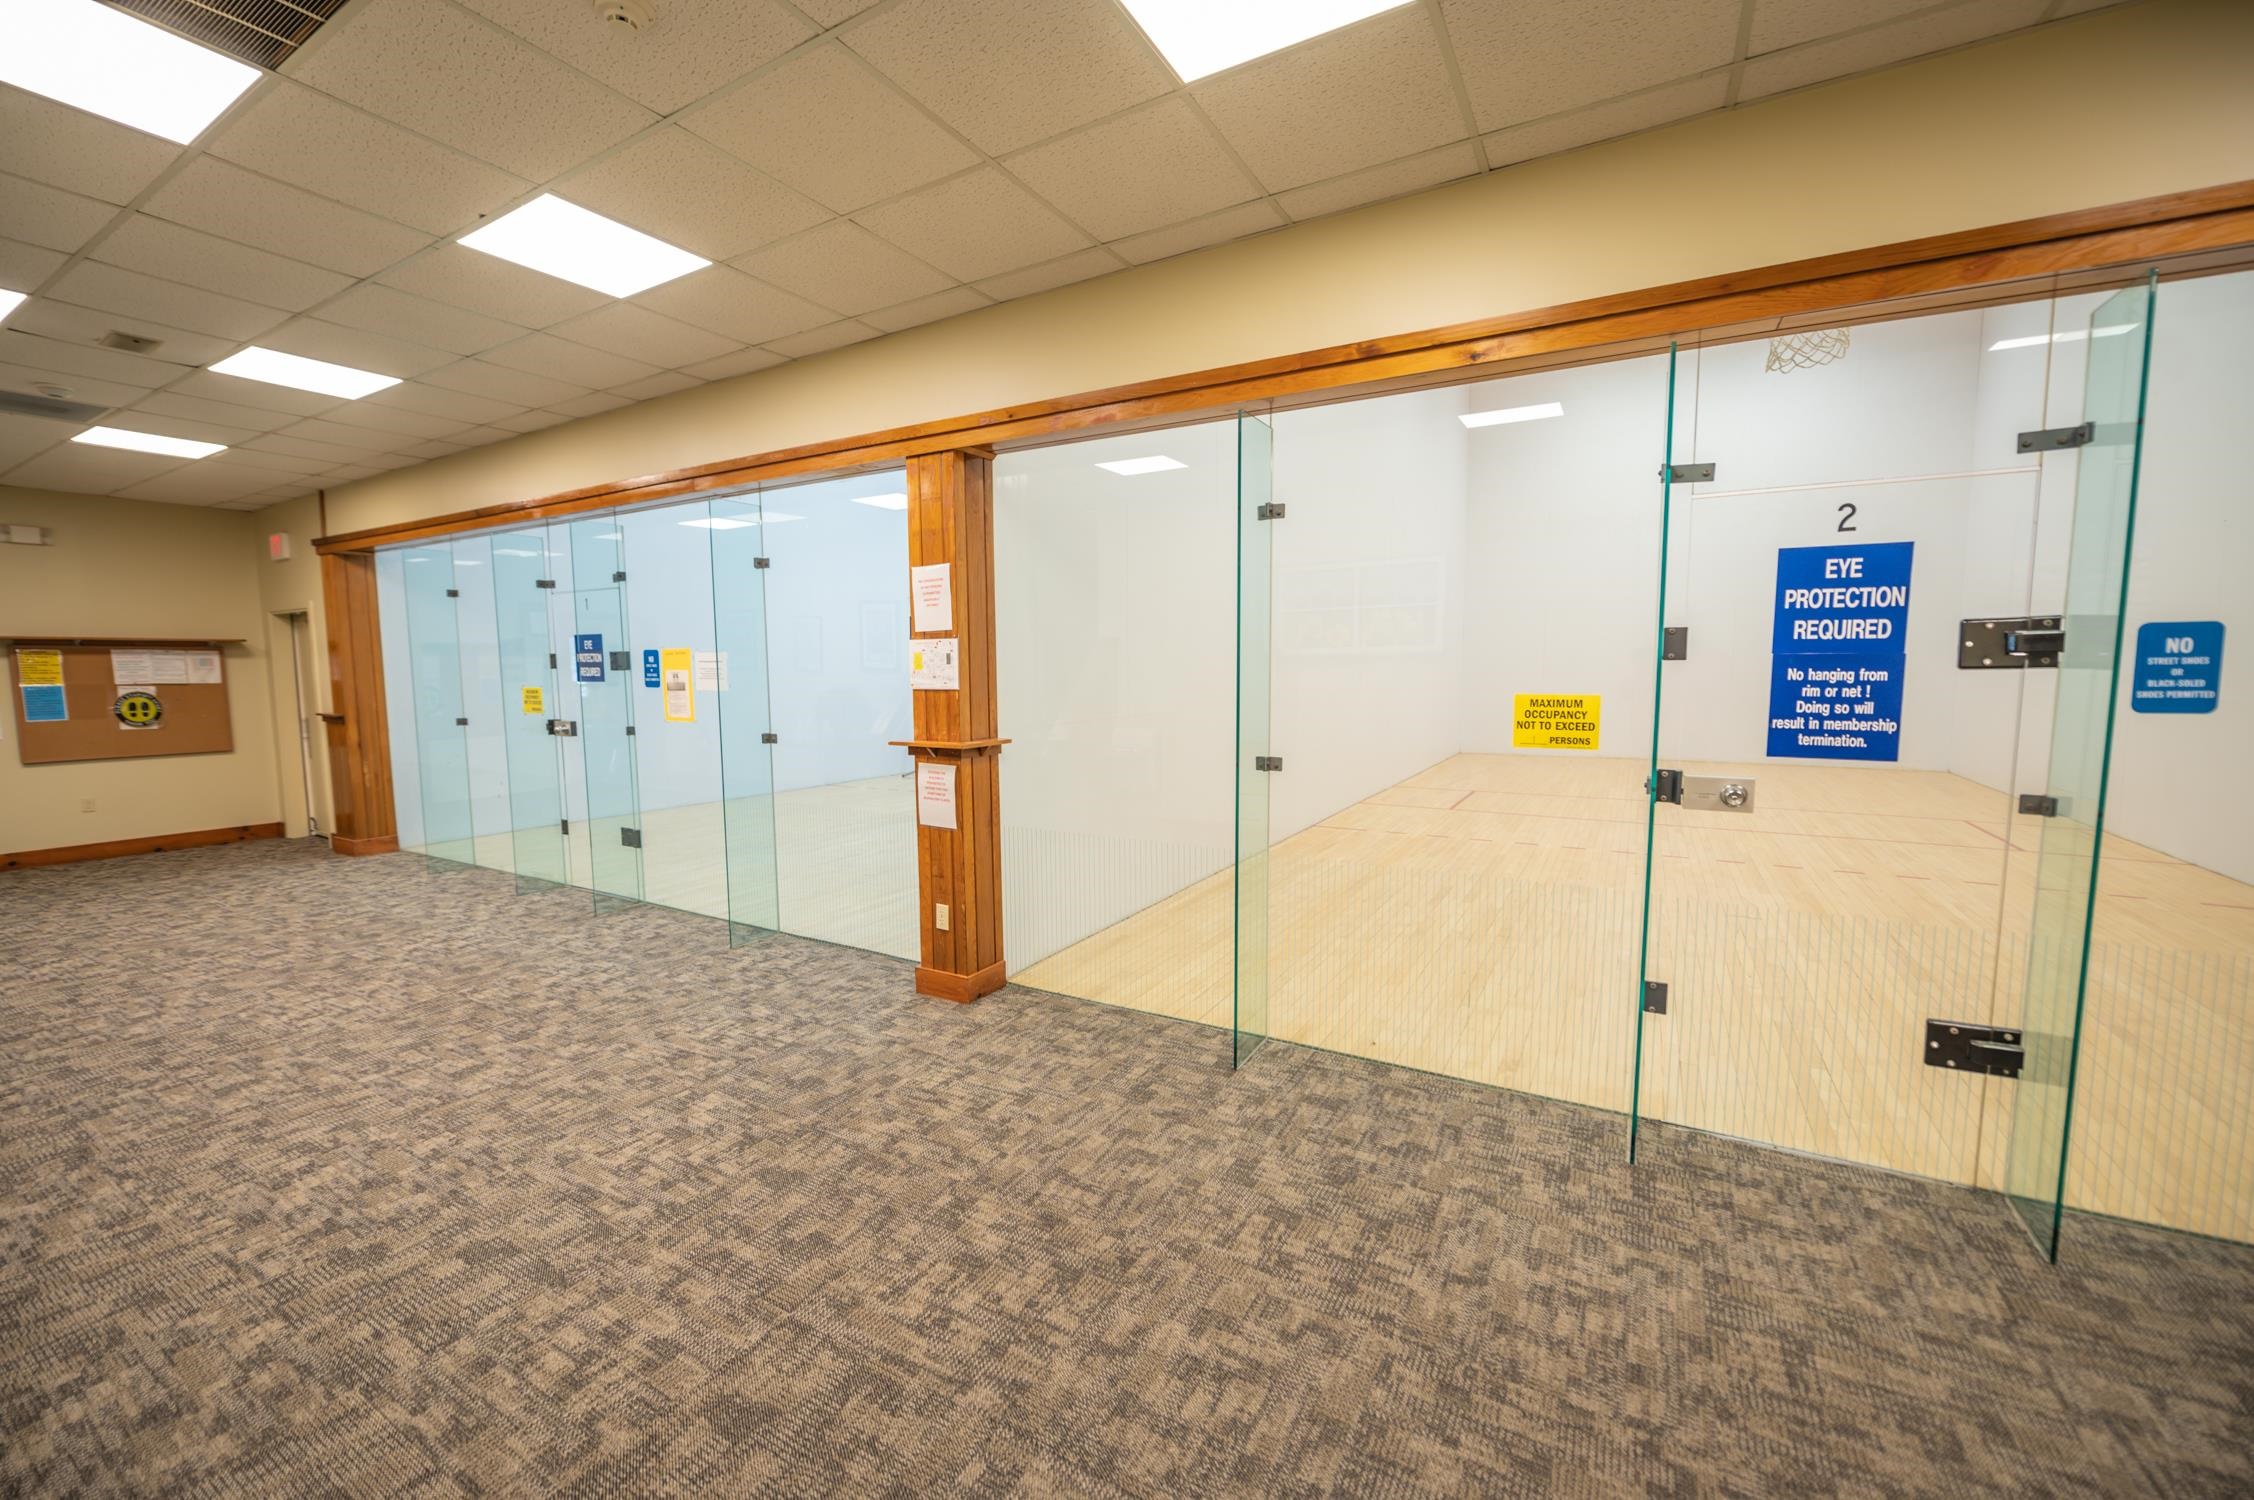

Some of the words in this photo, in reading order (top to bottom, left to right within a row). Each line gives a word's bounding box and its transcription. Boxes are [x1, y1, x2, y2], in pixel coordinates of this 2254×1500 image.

[1837, 502, 1857, 532] 2
[1824, 557, 1864, 579] EYE
[1784, 586, 1907, 610] PROTECTION
[1793, 619, 1892, 641] REQUIRED
[2165, 637, 2194, 654] NO
[2147, 657, 2179, 665] STREET
[2181, 656, 2210, 665] SHOES
[1787, 668, 1804, 681] No
[1808, 668, 1855, 684] hanging
[1859, 668, 1888, 682] from
[2170, 668, 2184, 676] OR
[1801, 684, 1821, 697] rim
[1824, 687, 1837, 698] or
[2166, 690, 2216, 698] PERMITTED
[1530, 699, 1583, 708] MAXIMUM
[1796, 701, 1830, 716] Doing
[1834, 703, 1849, 714] so
[1854, 701, 1874, 715] will
[1524, 710, 1588, 720] OCCUPANCY
[1516, 721, 1536, 730] NOT
[1539, 721, 1551, 730] TO
[1555, 722, 1595, 731] EXCEED
[1772, 717, 1805, 730] result
[1808, 717, 1820, 730] in
[1823, 718, 1897, 734] membership
[1549, 736, 1591, 745] PERSONS
[1798, 733, 1867, 748] termination.
